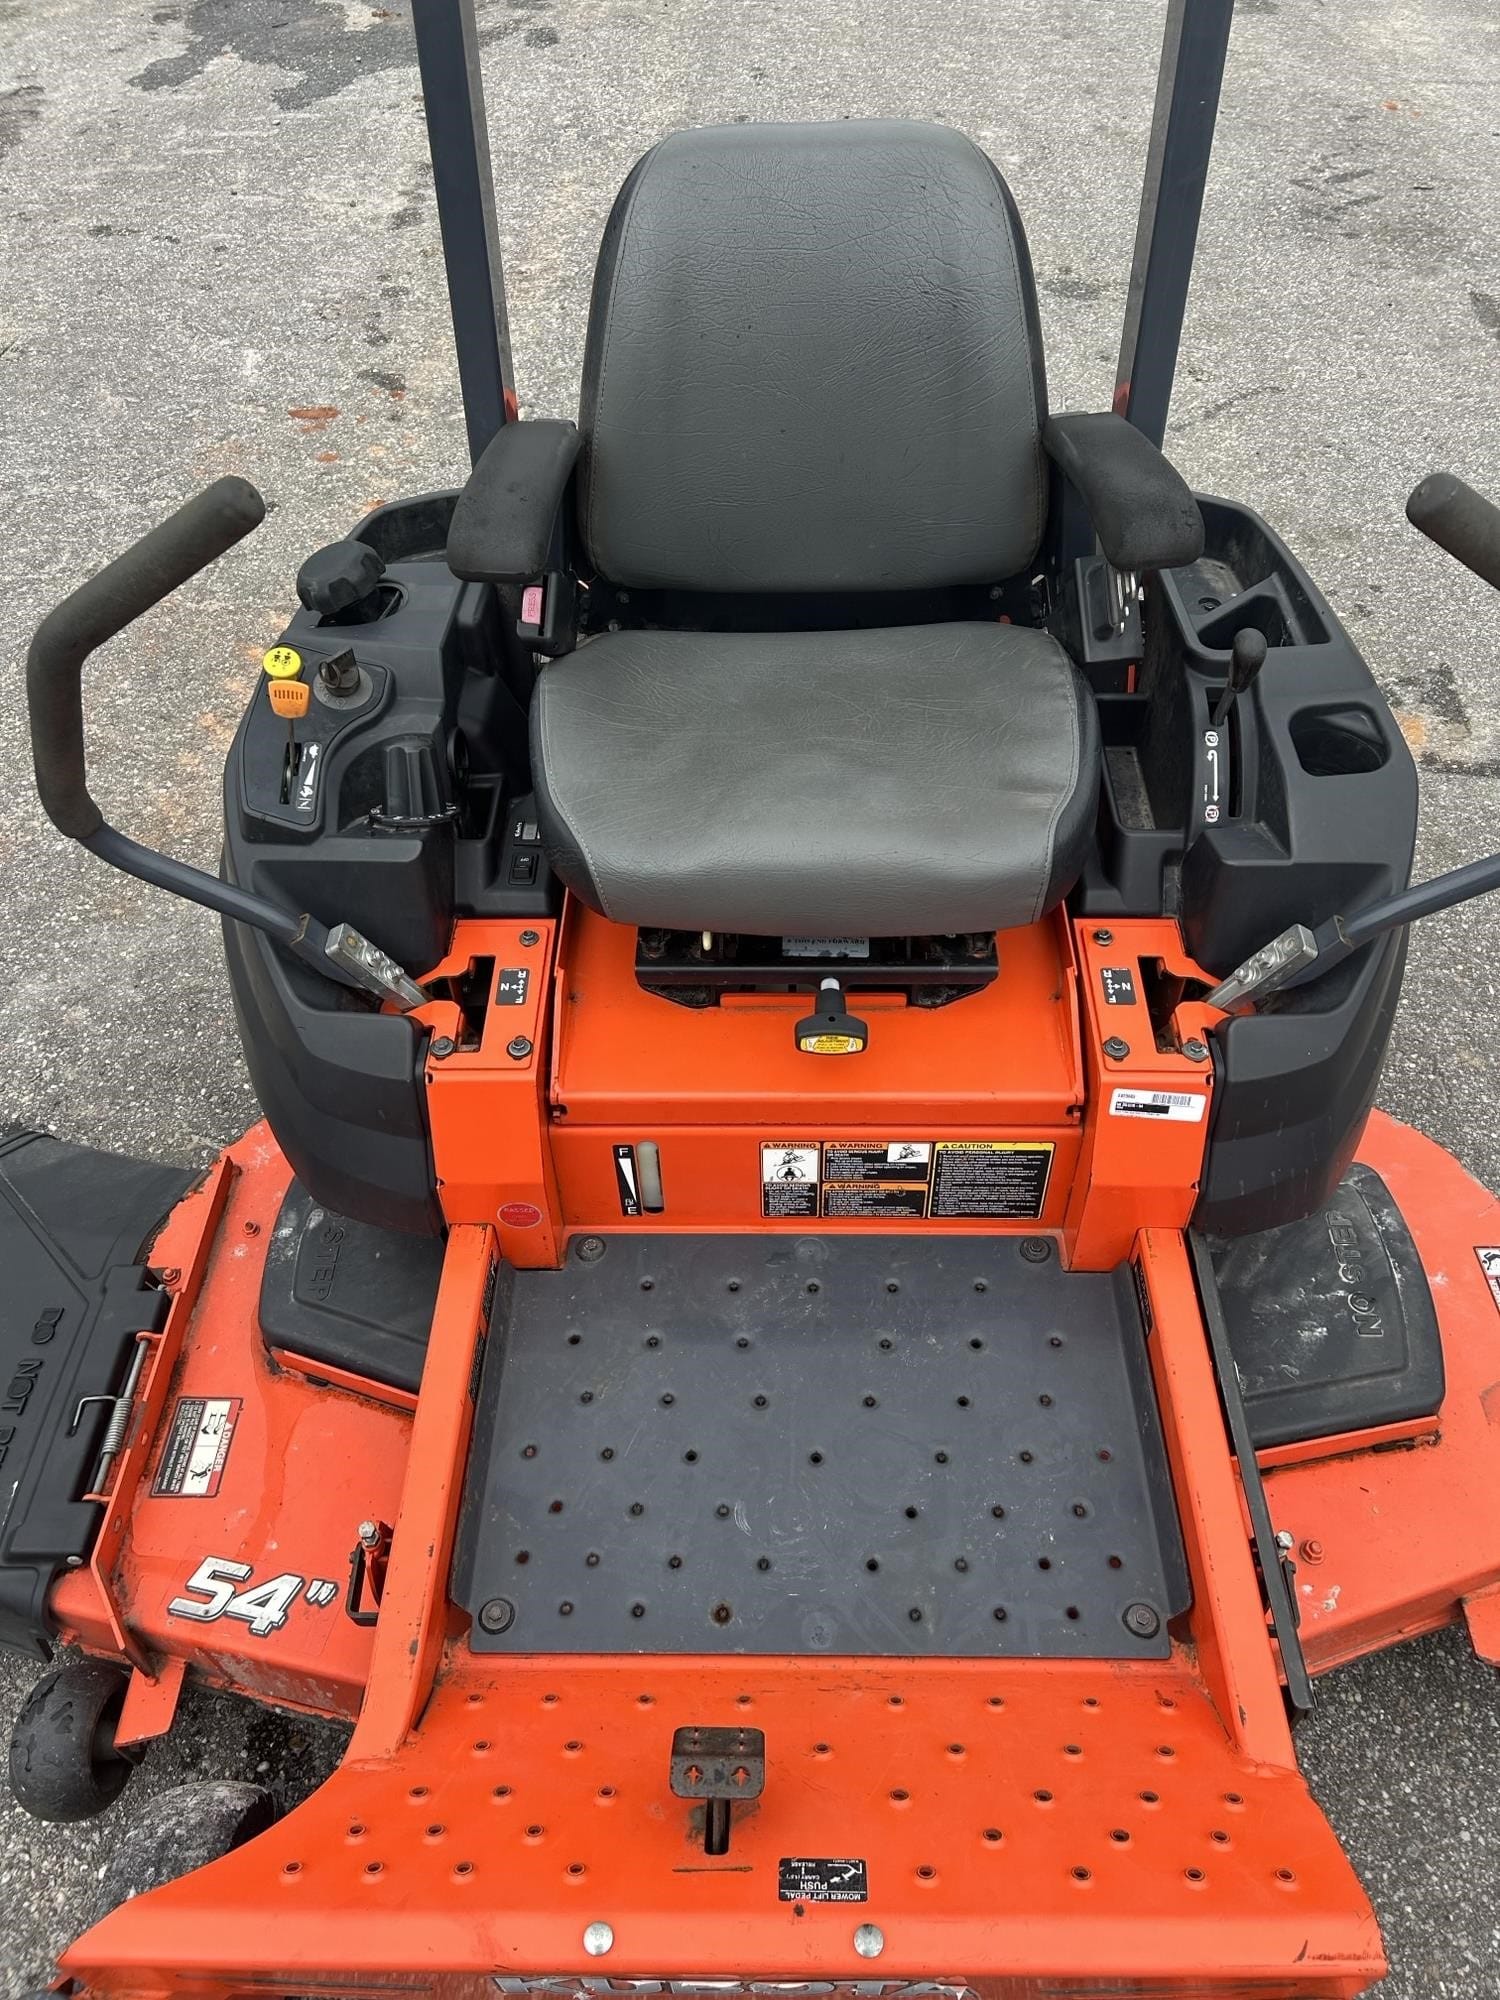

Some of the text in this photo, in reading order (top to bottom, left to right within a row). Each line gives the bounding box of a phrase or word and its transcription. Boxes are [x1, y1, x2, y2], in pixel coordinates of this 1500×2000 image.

[528, 592, 537, 617] PRESS
[1122, 982, 1131, 990] N
[515, 996, 523, 1004] F
[1109, 995, 1116, 1003] F
[619, 1148, 629, 1156] F
[628, 1206, 638, 1214] E
[308, 1226, 345, 1302] STEP
[1325, 1210, 1385, 1337] NO STEP
[31, 1307, 65, 1344] DO
[1, 1358, 44, 1416] NOT
[212, 1432, 231, 1472] DANGER
[167, 1555, 339, 1639] 54"
[800, 1882, 828, 1890] PUSH
